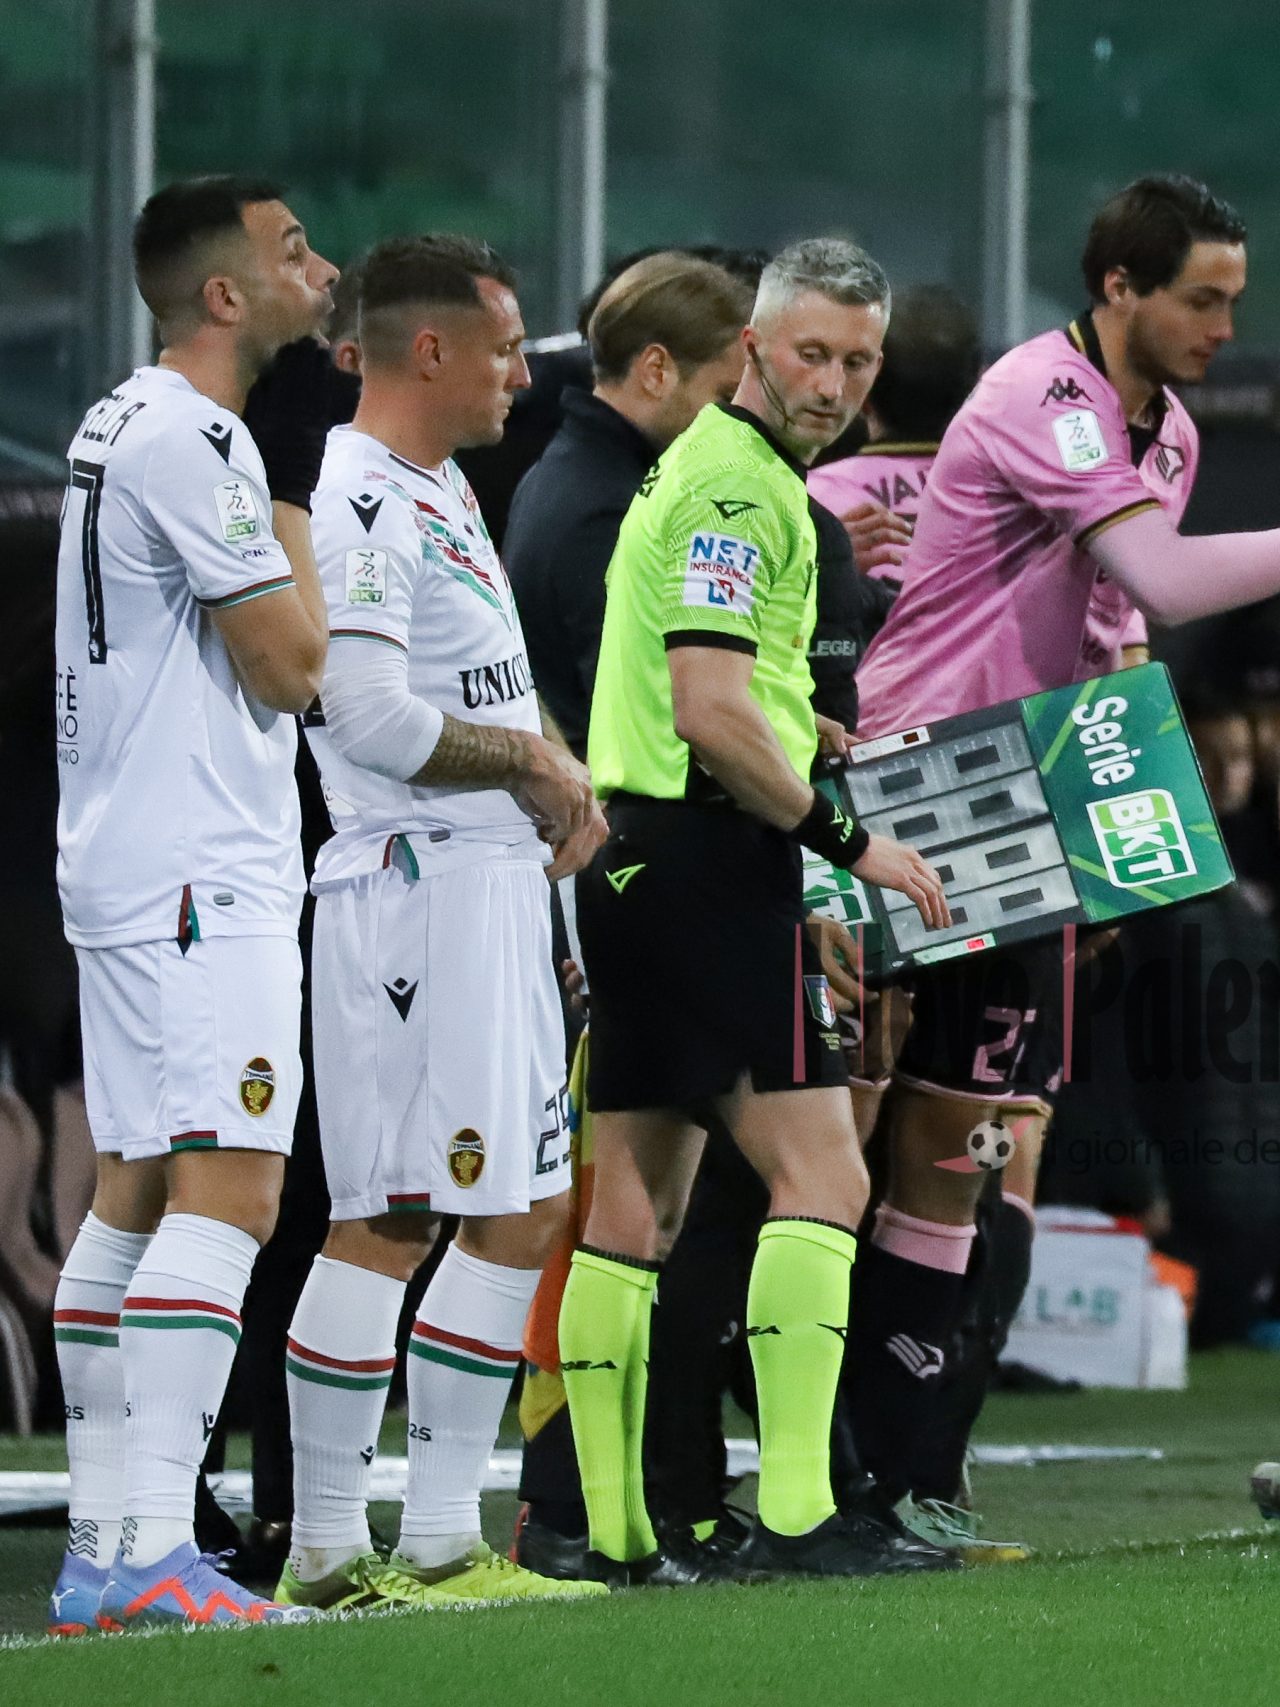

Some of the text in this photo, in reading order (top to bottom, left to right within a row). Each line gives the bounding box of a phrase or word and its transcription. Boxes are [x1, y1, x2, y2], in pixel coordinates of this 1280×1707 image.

[692, 536, 757, 572] NET
[1072, 696, 1142, 786] Serie
[1102, 793, 1182, 878] BKT
